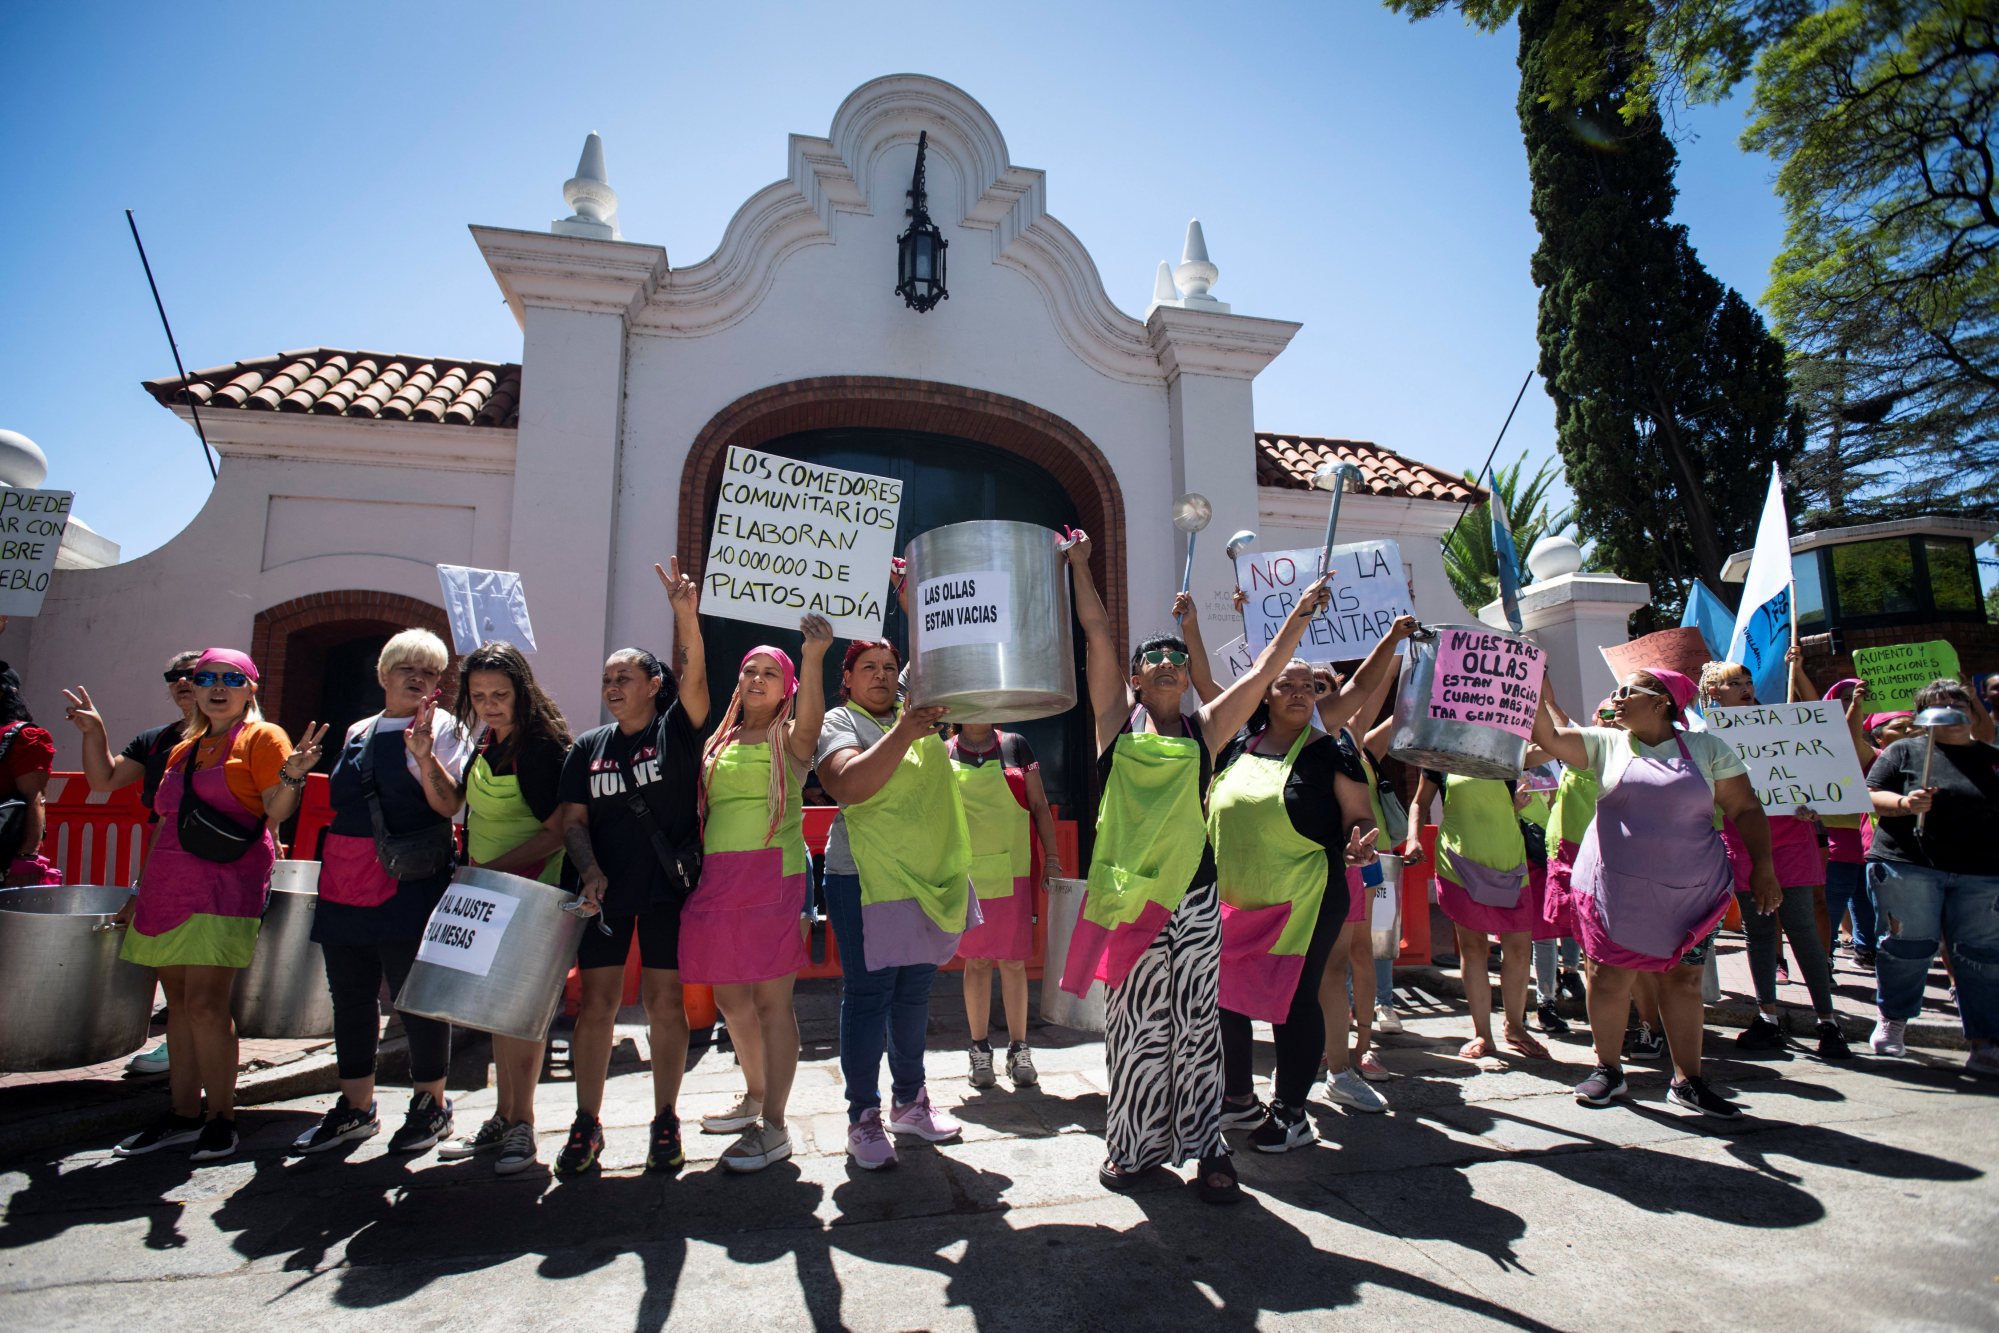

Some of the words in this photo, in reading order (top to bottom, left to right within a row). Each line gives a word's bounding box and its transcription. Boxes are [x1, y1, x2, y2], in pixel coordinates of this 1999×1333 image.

[728, 447, 772, 480] LOS
[778, 462, 901, 504] COMEDORES
[0, 491, 71, 515] PUEDE
[26, 519, 66, 536] CON
[717, 513, 859, 550] ELABORAN
[2, 541, 45, 560] BRE
[812, 560, 850, 582] DE
[1251, 558, 1296, 591] NO
[1355, 549, 1391, 578] LA
[705, 573, 805, 608] PLATOS
[924, 584, 940, 606] LAS
[942, 579, 976, 601] OLLAS
[925, 608, 954, 632] ESTAN
[956, 604, 998, 626] VACIAS
[1451, 631, 1539, 661] NUESTRAS
[1860, 647, 1913, 666] AUMENTO
[1919, 645, 1925, 658] Y
[1462, 652, 1528, 681] OLLAS
[1442, 674, 1493, 688] ESTAN
[1499, 698, 1523, 713] MAS
[1705, 708, 1783, 730] BASTA
[1791, 706, 1828, 726] DE
[1769, 765, 1798, 781] AL
[451, 896, 497, 923] AJUSTE
[438, 924, 477, 950] MESAS
[336, 1119, 360, 1136] FILA
